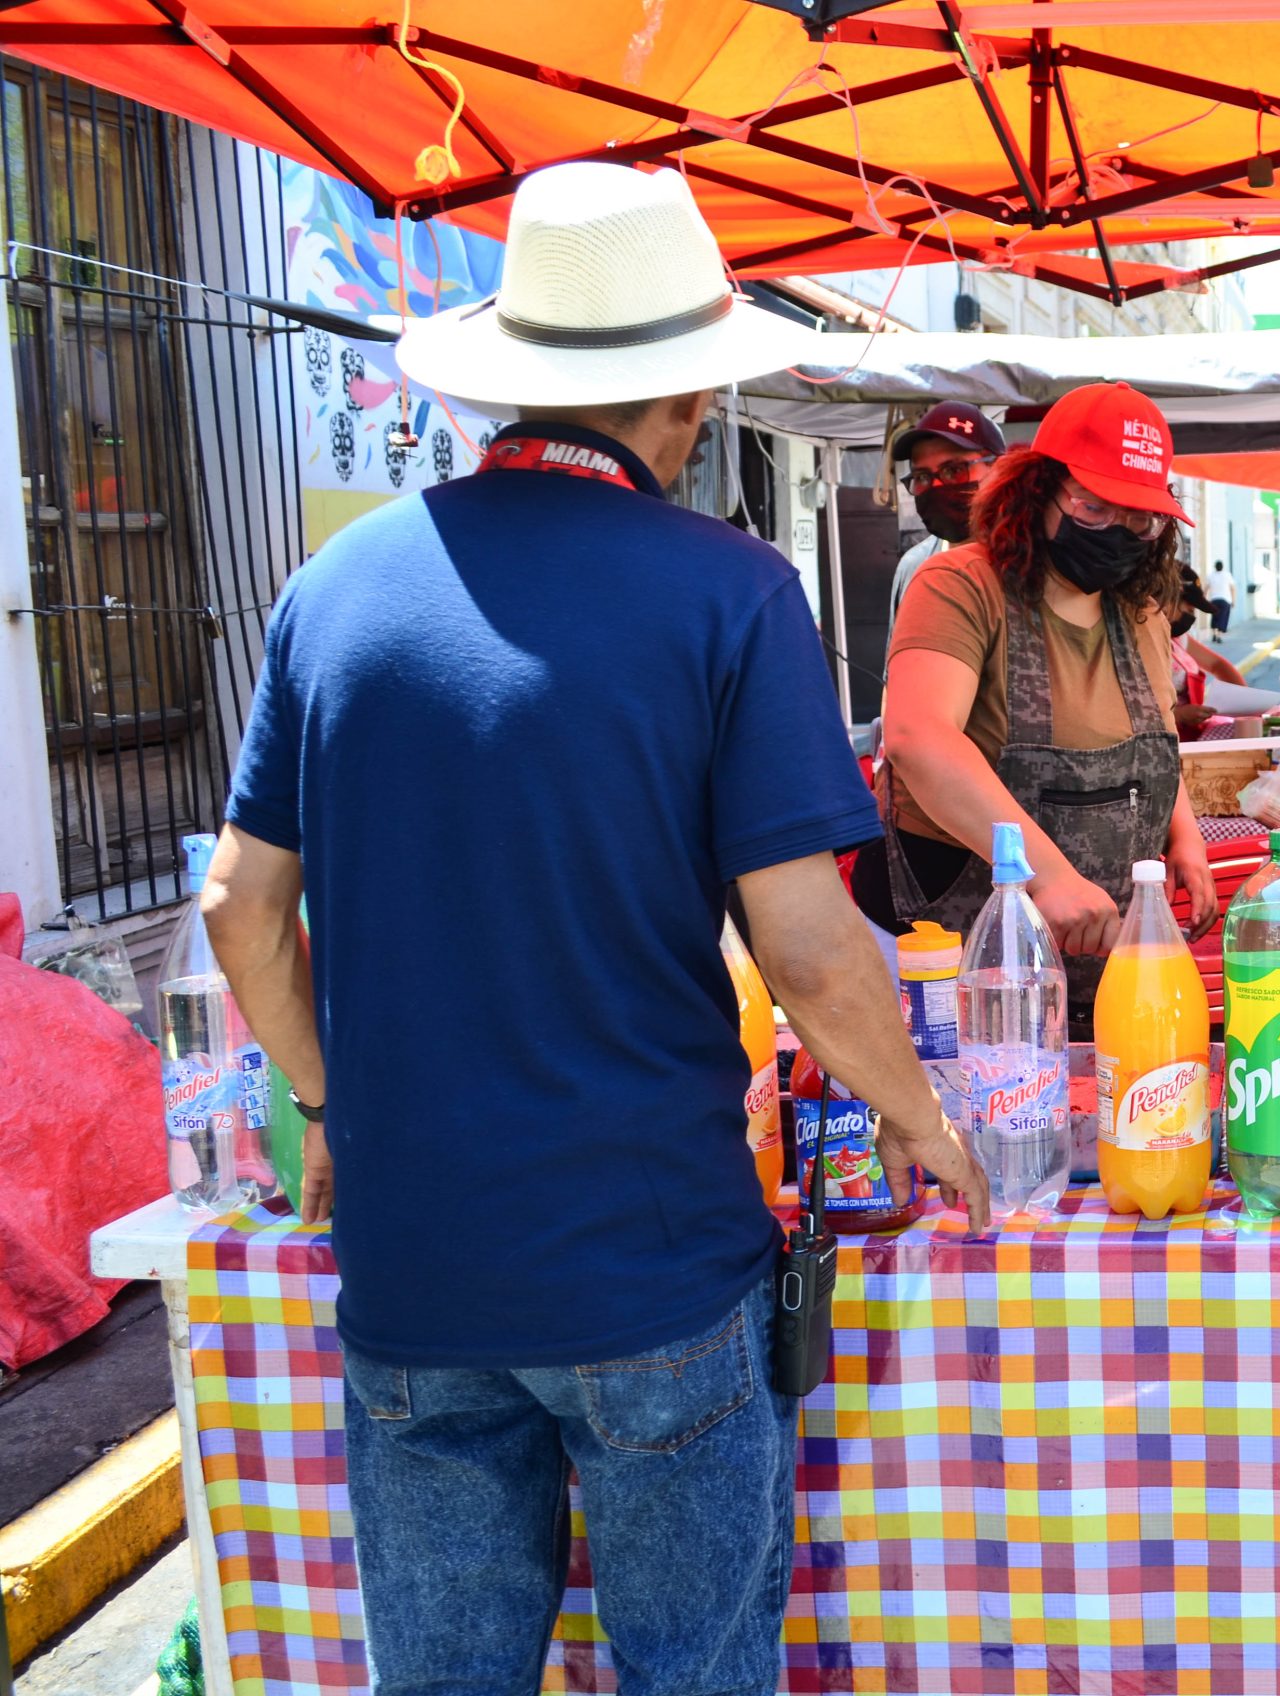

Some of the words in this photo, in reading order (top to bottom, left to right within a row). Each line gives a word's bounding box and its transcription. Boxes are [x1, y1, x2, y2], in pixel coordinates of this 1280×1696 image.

[1139, 440, 1154, 455] ES
[541, 441, 620, 476] MIAMI
[1122, 452, 1163, 474] CHINGÓN
[987, 1061, 1061, 1126] Peñafiel
[1129, 1062, 1199, 1124] Peñafiel
[173, 1115, 205, 1129] Sifón
[1009, 1115, 1048, 1131] Sifón
[830, 1199, 849, 1207] TOMATE
[849, 1199, 860, 1207] CON
[860, 1199, 869, 1207] UN
[868, 1197, 885, 1208] TOQUE
[884, 1196, 893, 1205] DE
